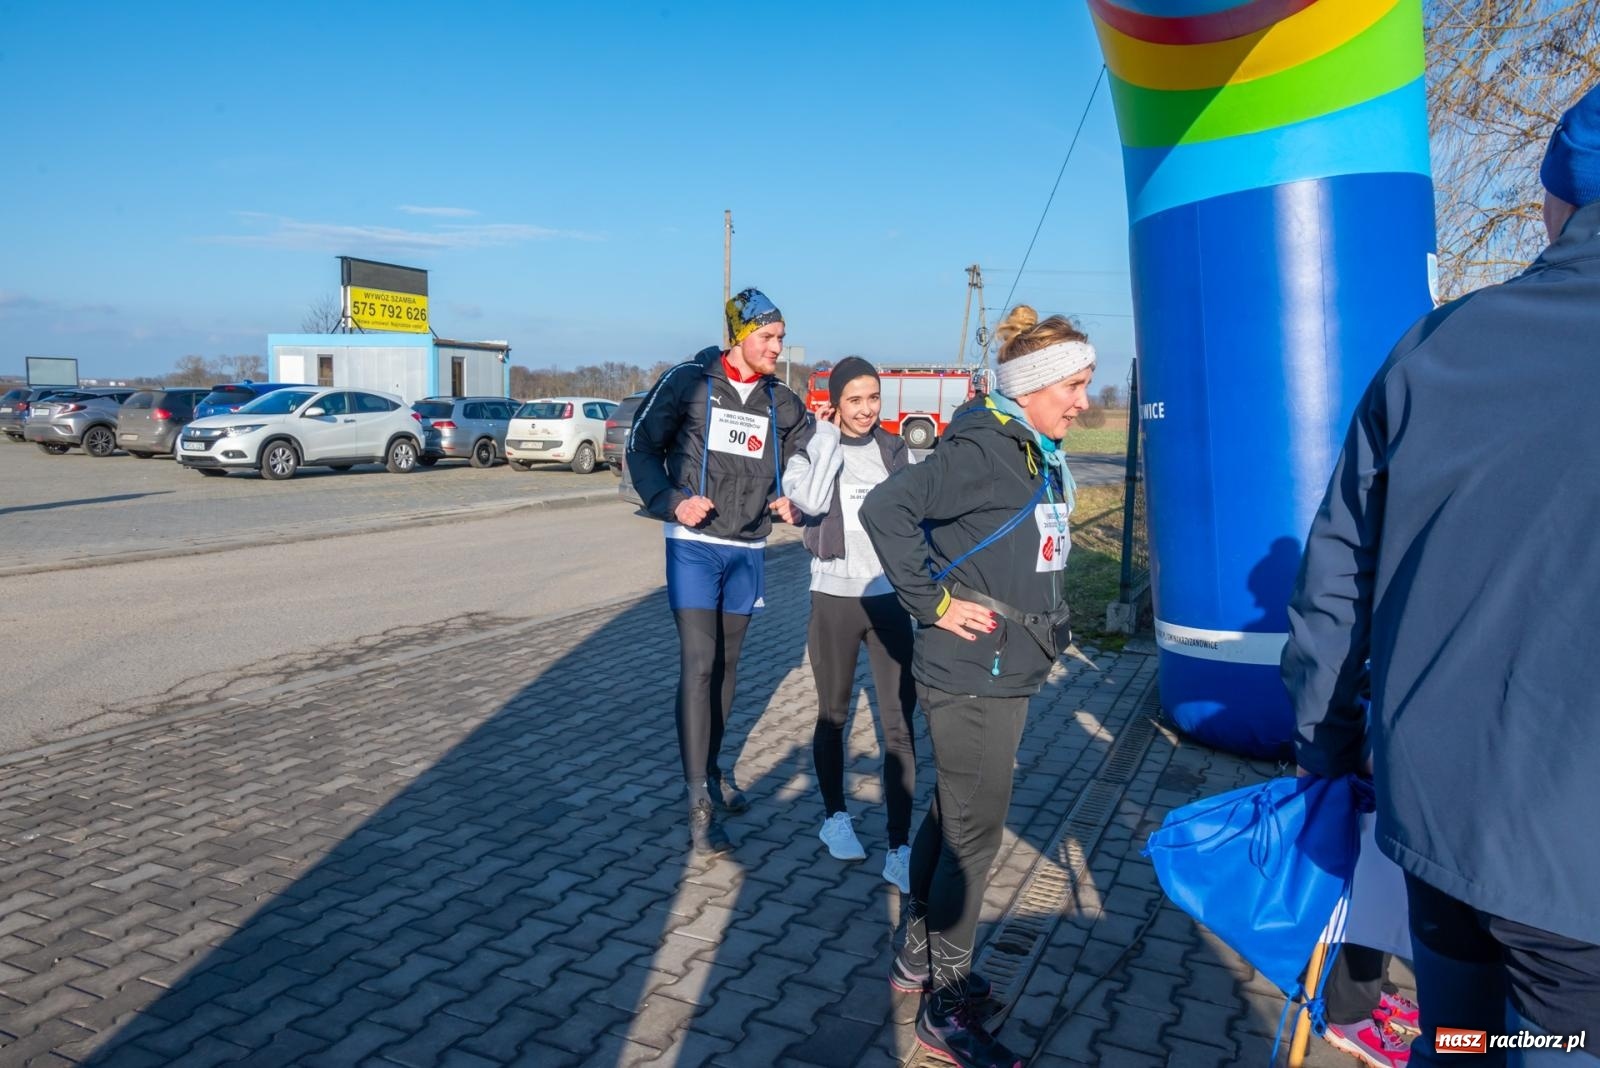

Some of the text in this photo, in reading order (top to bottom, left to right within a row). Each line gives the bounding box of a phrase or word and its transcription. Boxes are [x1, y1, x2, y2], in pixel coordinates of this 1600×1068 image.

[363, 291, 416, 303] WYWÓZ SZAMBA
[353, 301, 427, 321] 575 792 626
[728, 429, 746, 445] 90
